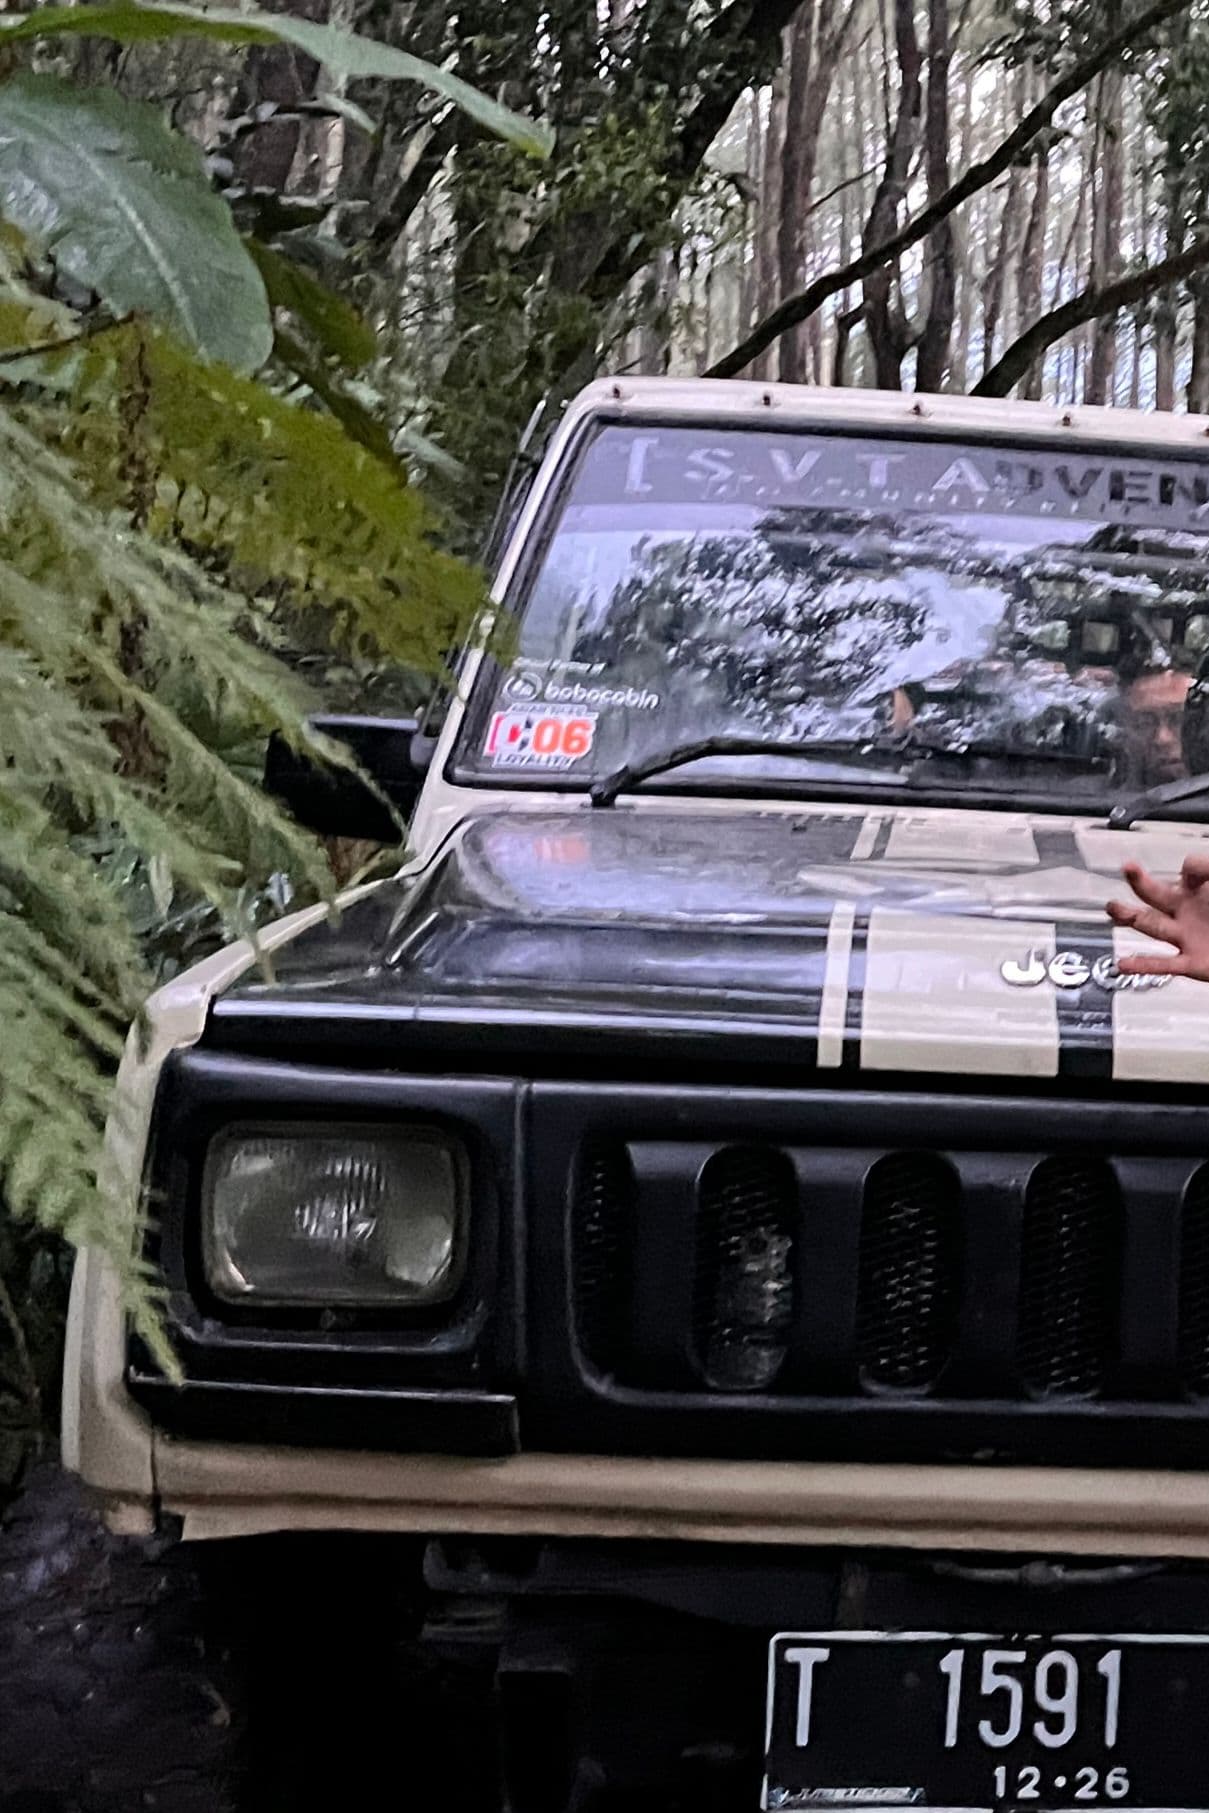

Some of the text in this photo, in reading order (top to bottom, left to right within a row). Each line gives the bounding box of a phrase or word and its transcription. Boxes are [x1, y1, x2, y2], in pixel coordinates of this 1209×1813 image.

[544, 681, 660, 709] bobocabin
[532, 717, 593, 755] 06
[784, 1647, 830, 1747] T
[939, 1649, 1122, 1748] 1591
